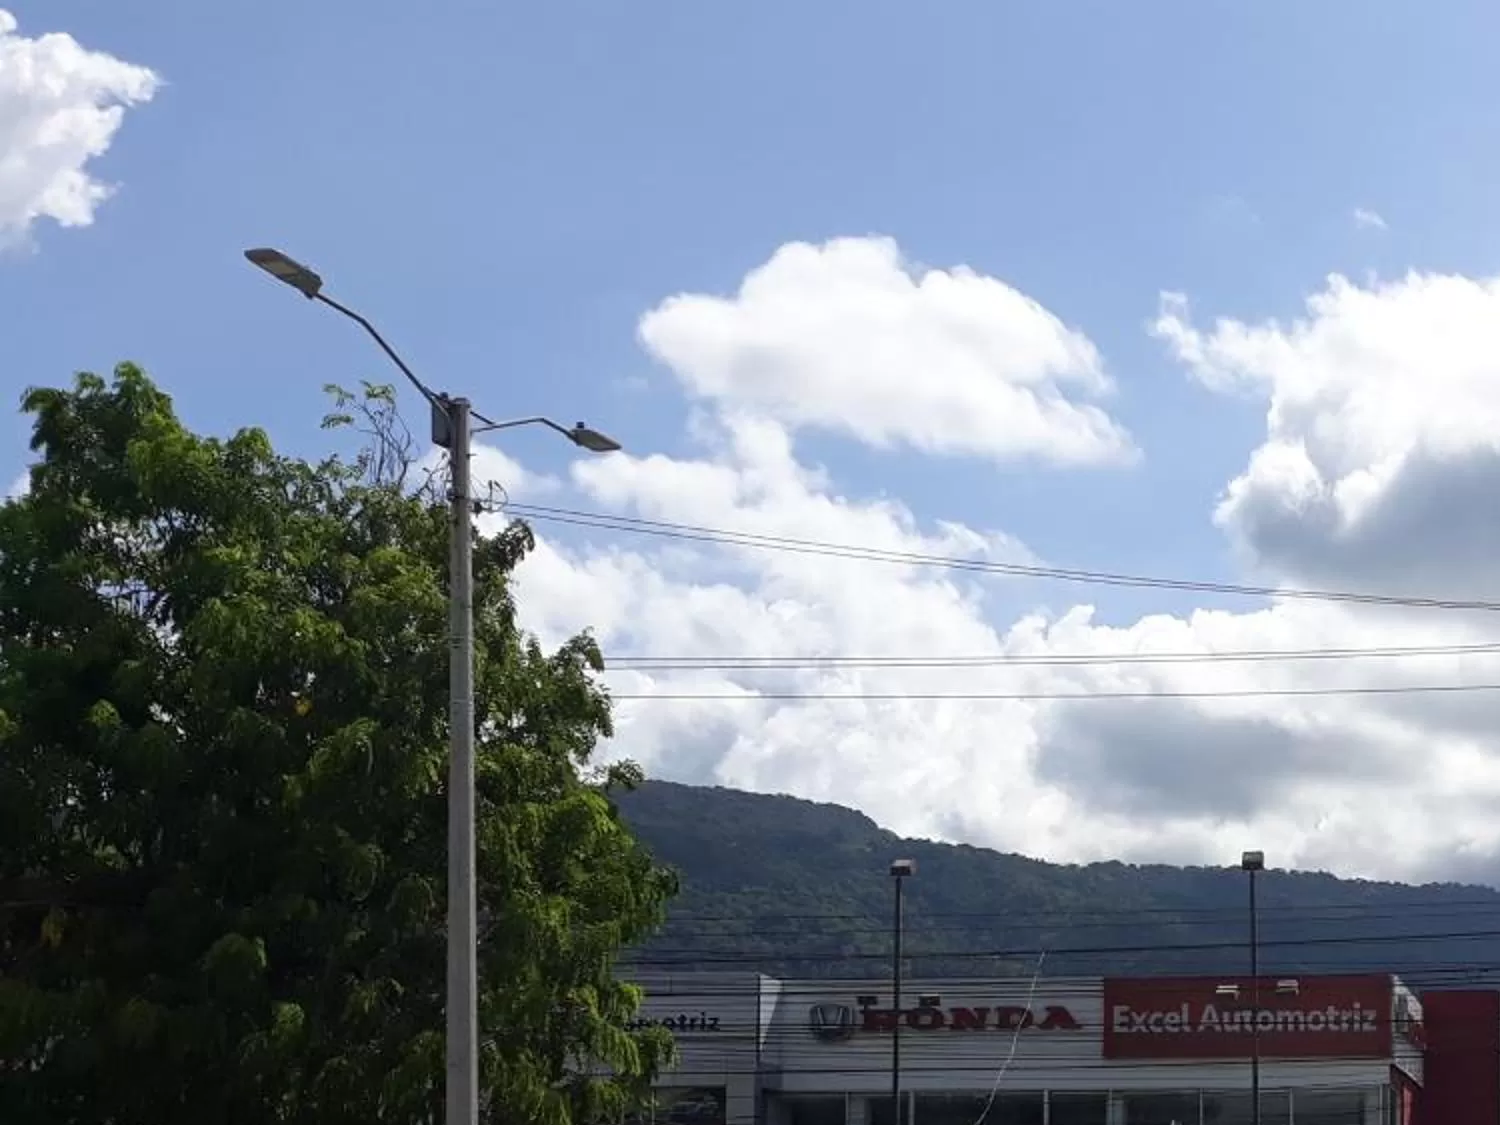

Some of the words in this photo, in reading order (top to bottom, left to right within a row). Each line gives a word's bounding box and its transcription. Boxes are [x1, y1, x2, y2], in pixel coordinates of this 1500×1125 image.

[862, 1006, 1083, 1031] HONDA
[1113, 1002, 1192, 1034] Excel
[1197, 1002, 1378, 1034] Automotriz
